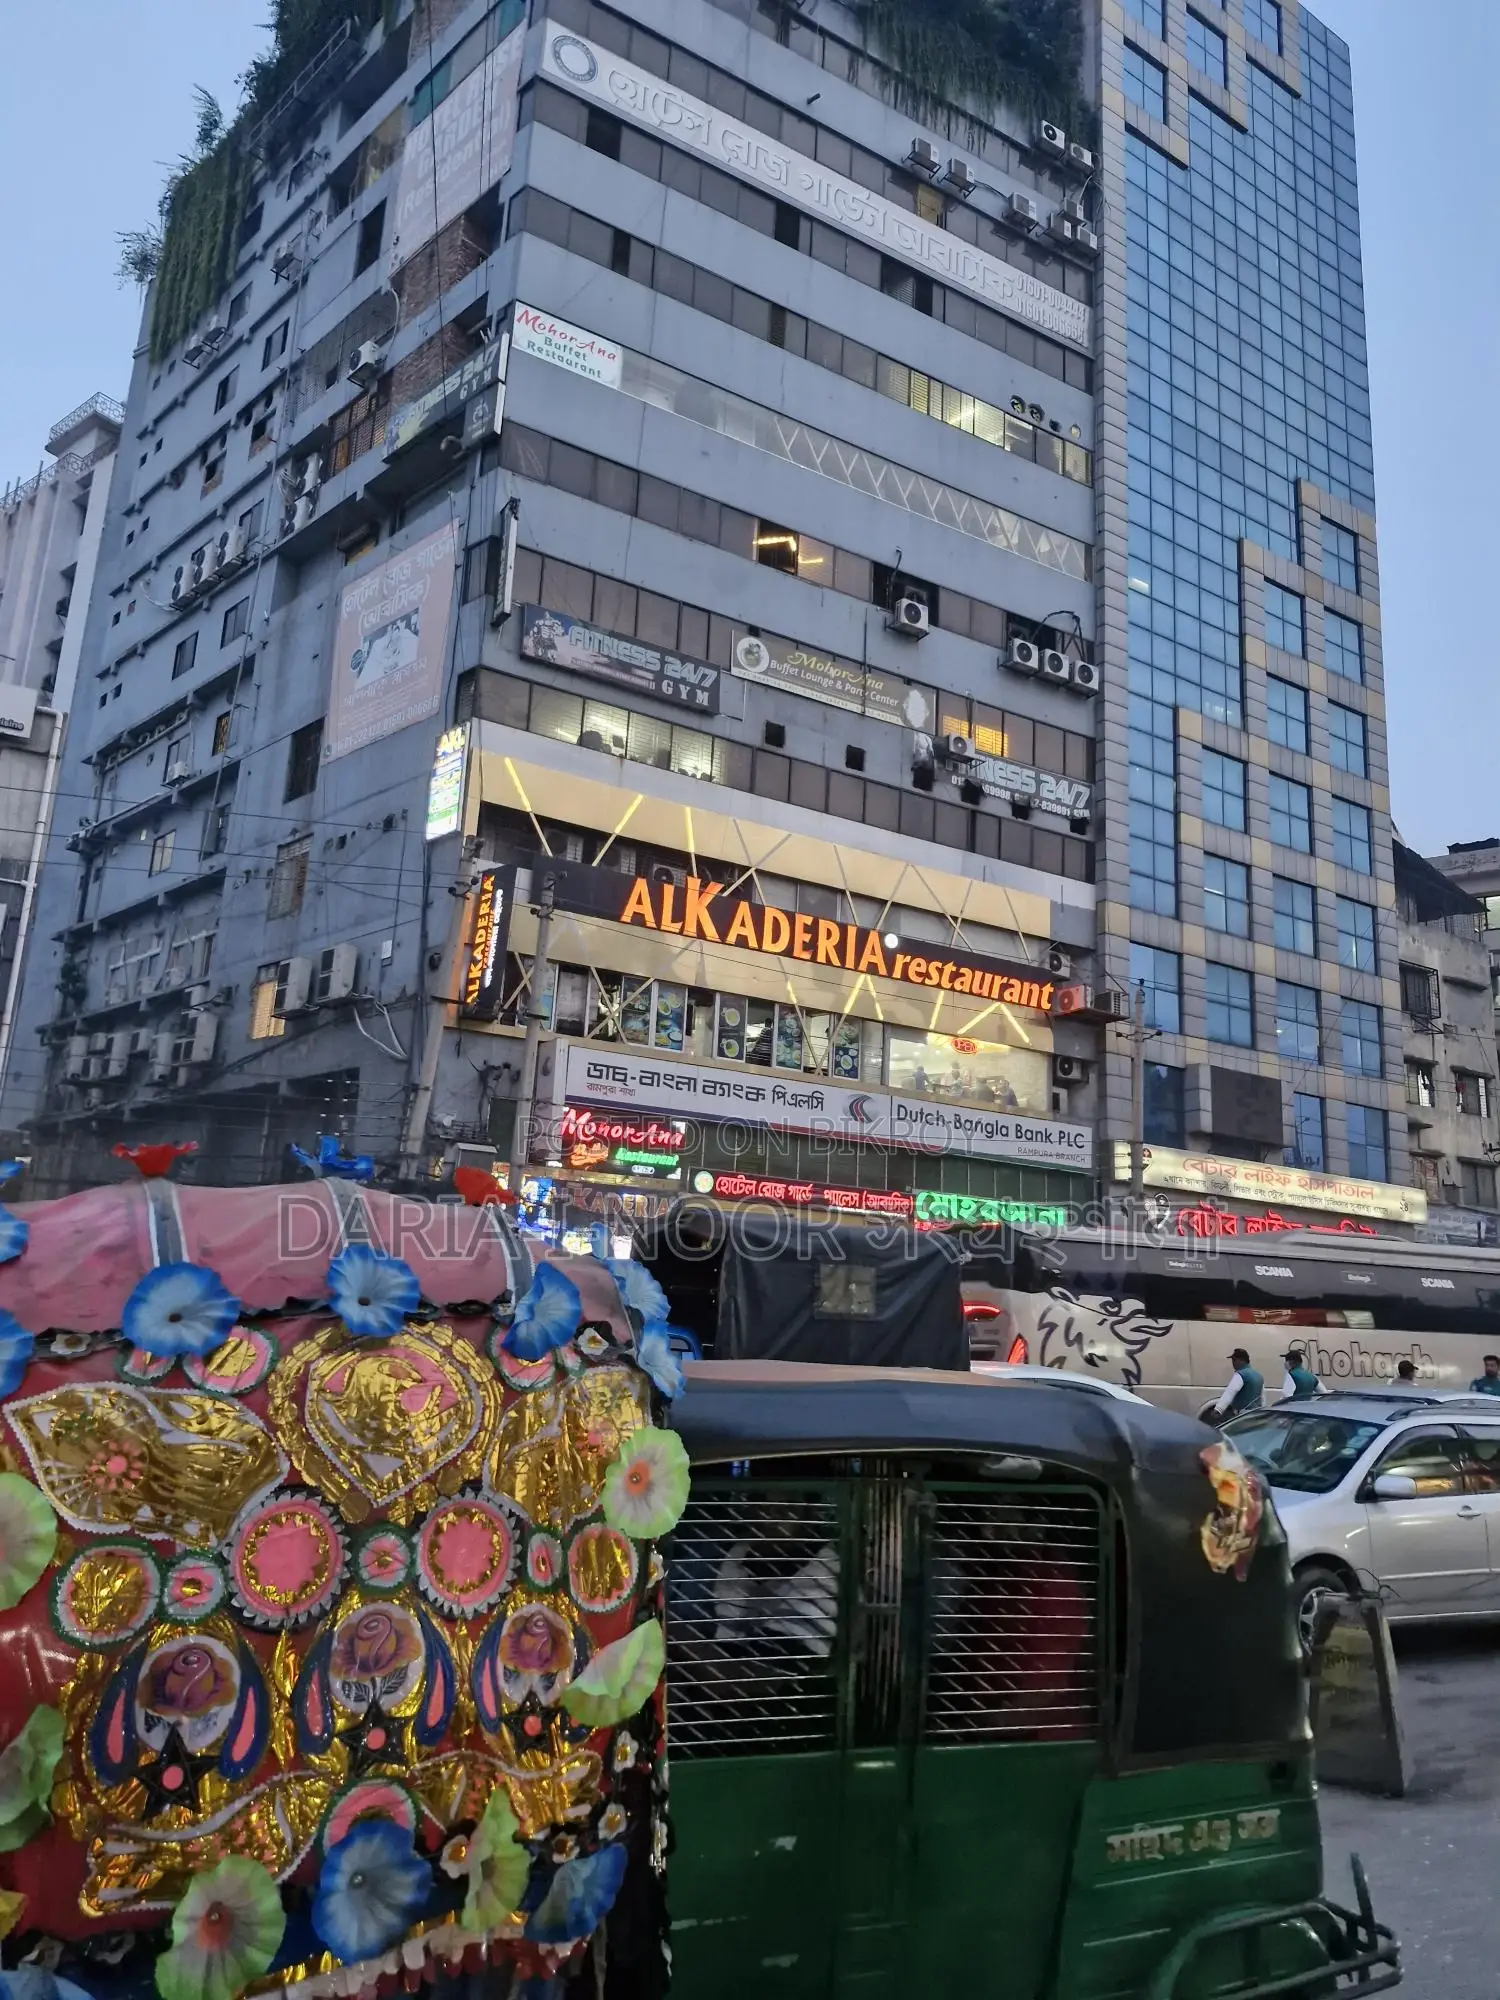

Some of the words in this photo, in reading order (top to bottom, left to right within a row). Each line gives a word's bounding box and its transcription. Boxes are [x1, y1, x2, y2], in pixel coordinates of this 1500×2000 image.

[526, 340, 603, 379] Restaurant
[543, 336, 588, 361] Buffet
[664, 655, 718, 688] 24/7
[770, 659, 800, 677] Buffet
[801, 669, 835, 689] Lounge
[835, 679, 843, 691] &
[870, 690, 900, 707] Center
[661, 680, 710, 707] GYM
[1040, 774, 1091, 809] 24/7
[891, 953, 1055, 1010] restaurant
[587, 1061, 697, 1096] ডাচ্-বাংলা
[702, 1078, 766, 1103] ব্যাংক
[771, 1084, 826, 1112] পিএলসি
[896, 1104, 1010, 1139] Dutch-Bangla
[1015, 1123, 1054, 1144] Bank
[1058, 1131, 1086, 1149] PLC
[1017, 1147, 1053, 1158] RAMPURA
[1055, 1152, 1087, 1164] BRANCH
[715, 1175, 757, 1197] হোটেল
[758, 1181, 786, 1199] রোজ
[1183, 1157, 1238, 1179] বেটার
[1244, 1166, 1292, 1188] লাইফ
[1297, 1173, 1375, 1200] হাসপাতাল
[1254, 1265, 1295, 1279] SCANIA
[1420, 1276, 1456, 1290] SCANIA
